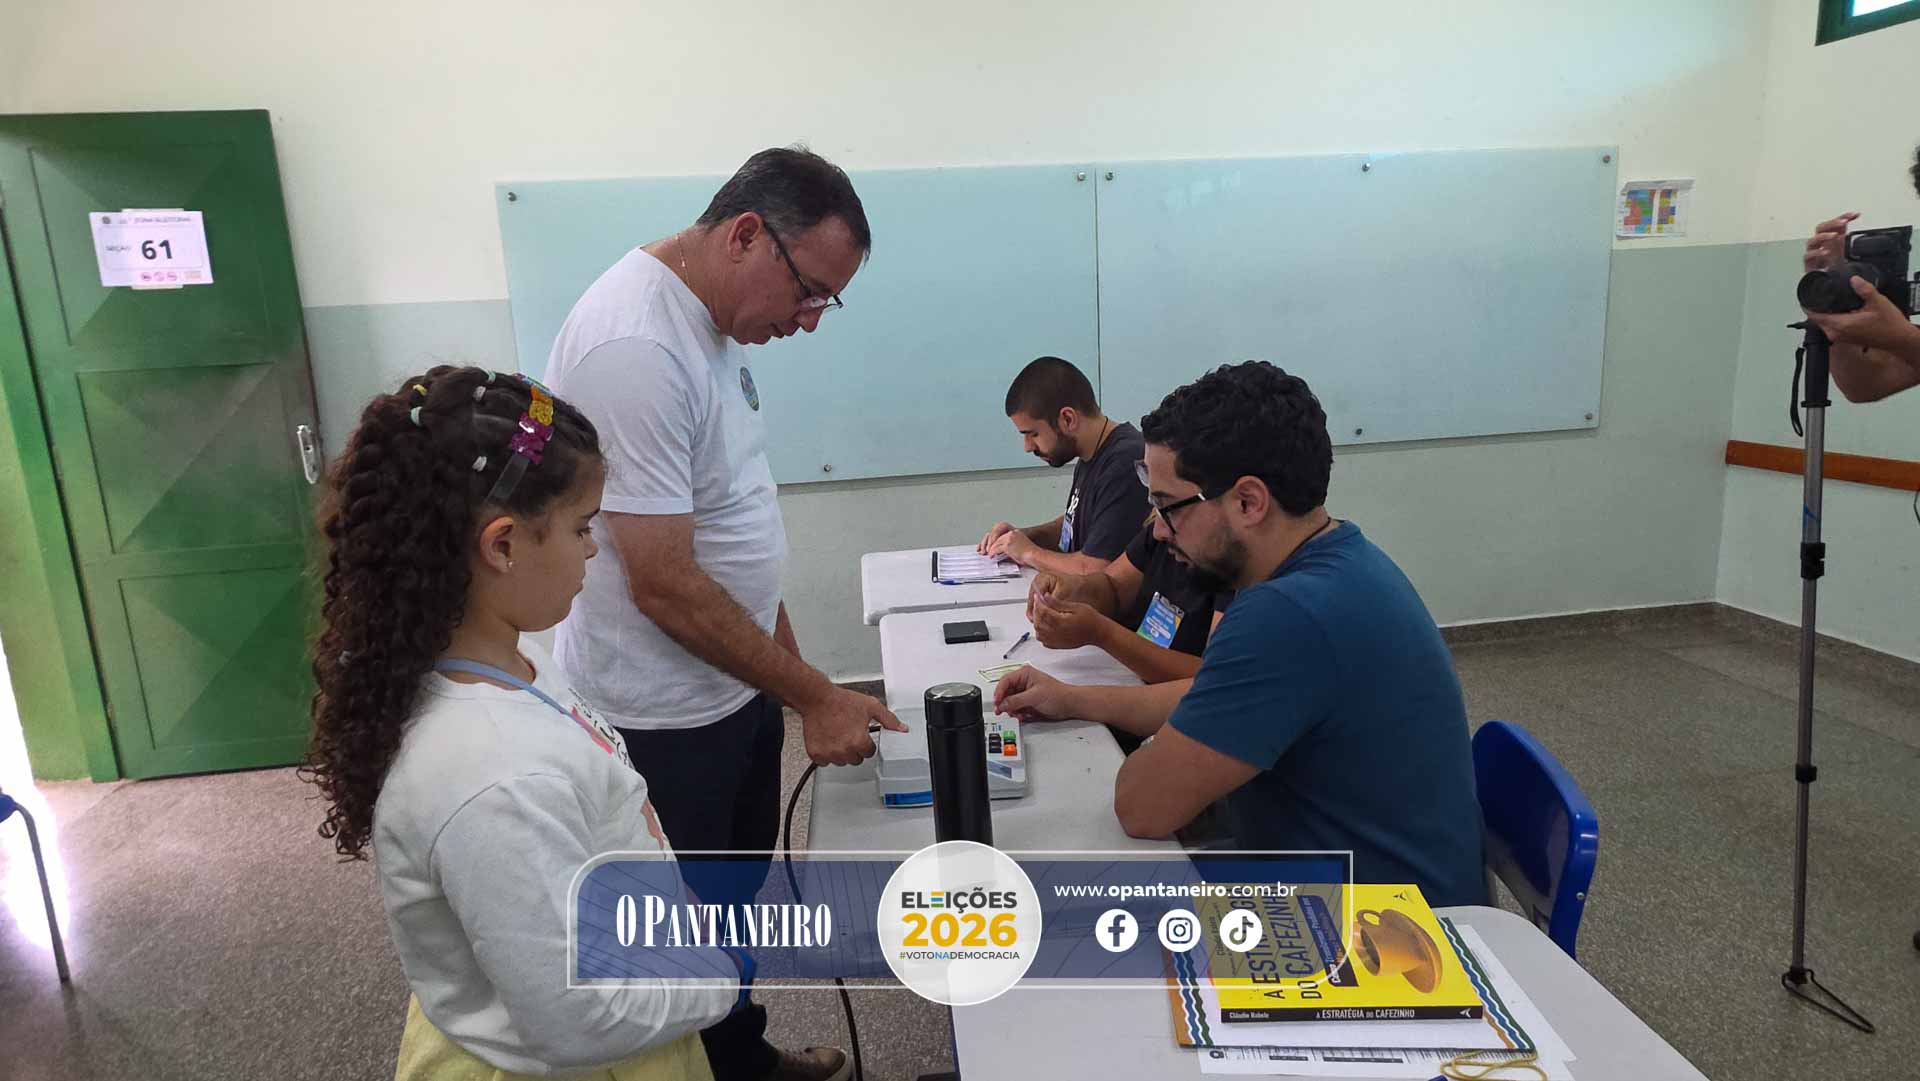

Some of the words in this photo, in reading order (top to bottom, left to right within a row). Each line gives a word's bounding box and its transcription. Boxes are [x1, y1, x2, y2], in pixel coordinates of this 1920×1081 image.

[141, 239, 173, 260] 61
[1264, 989, 1285, 999] A
[1297, 980, 1322, 999] DO
[1322, 1008, 1364, 1019] ESTRATÉGIA
[1375, 1008, 1415, 1018] CAFEZINHO
